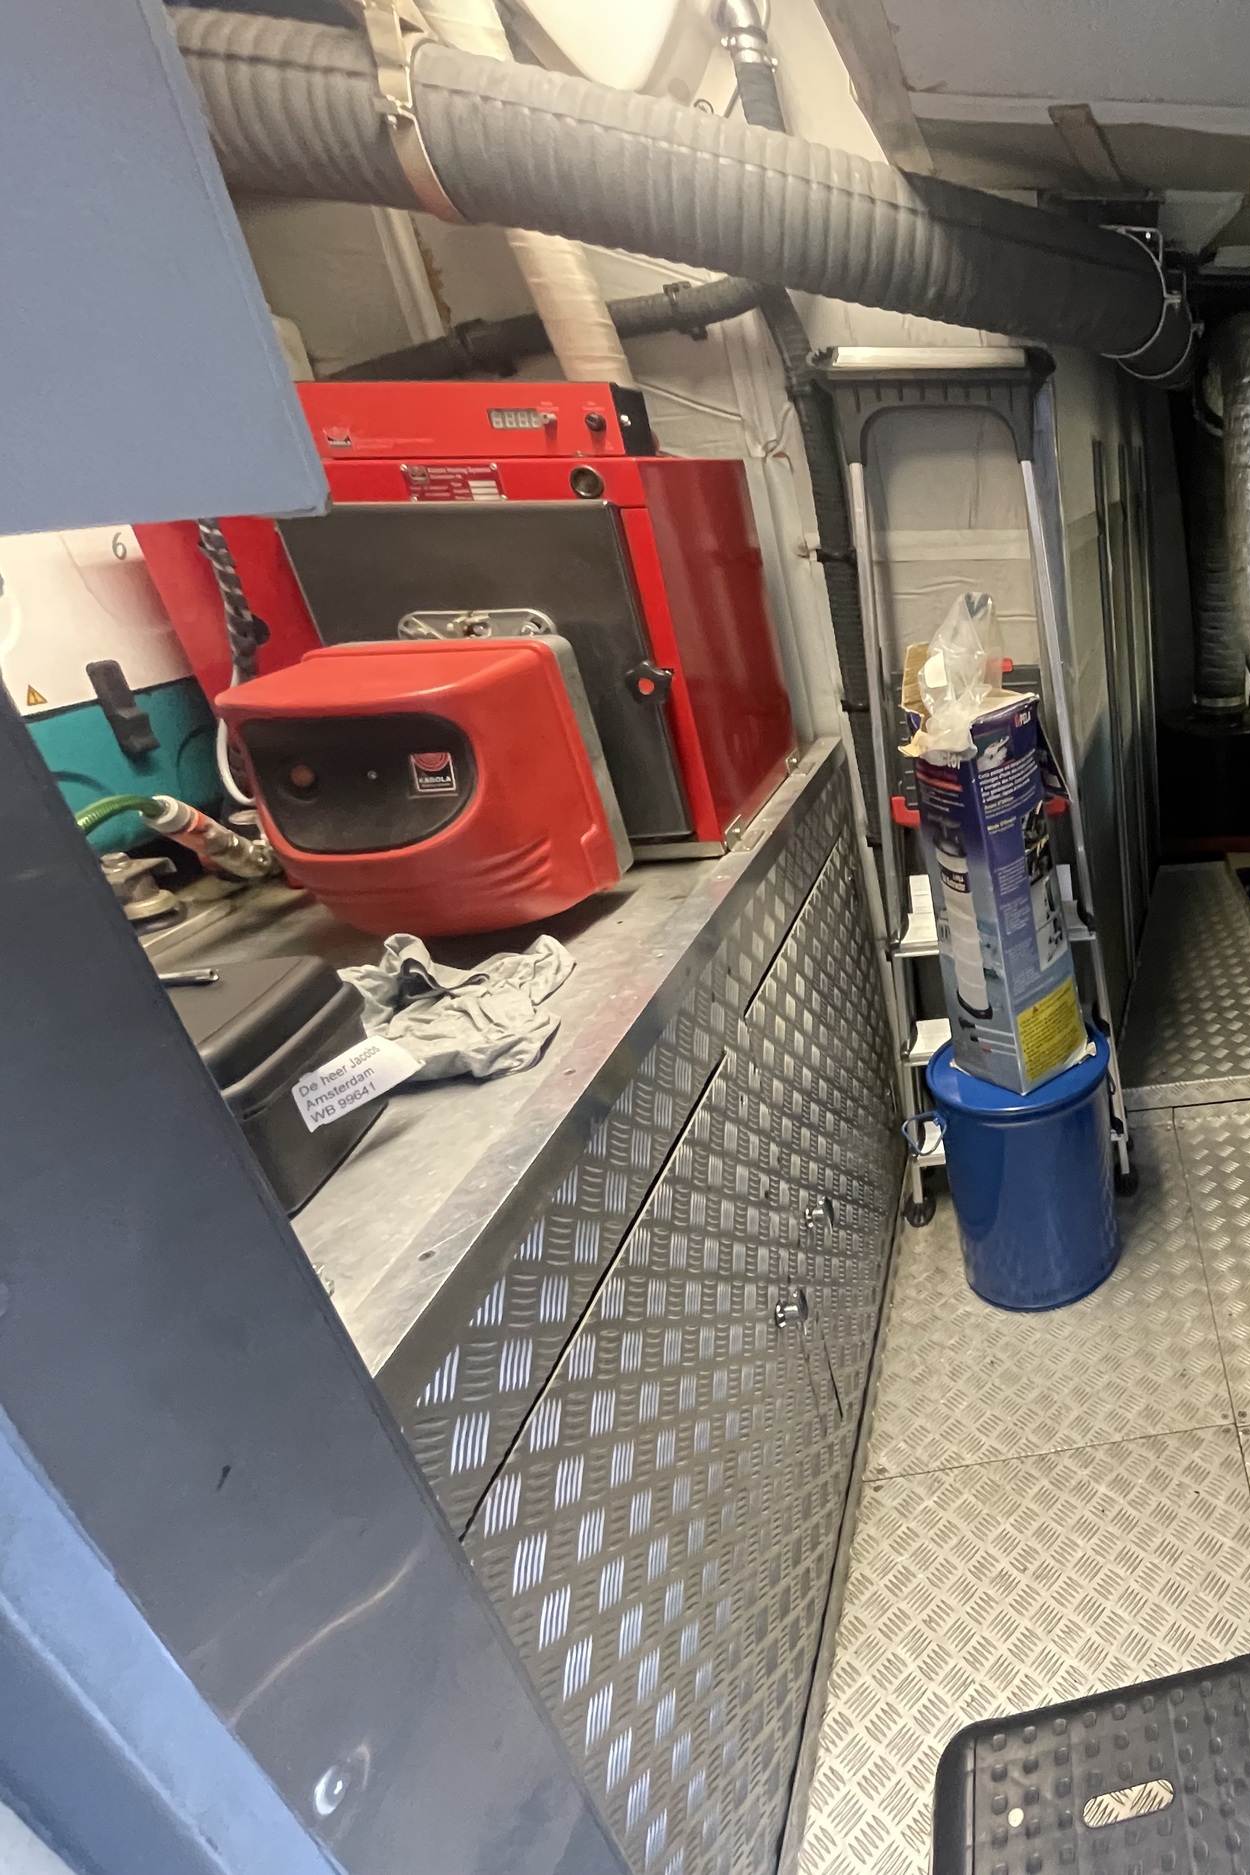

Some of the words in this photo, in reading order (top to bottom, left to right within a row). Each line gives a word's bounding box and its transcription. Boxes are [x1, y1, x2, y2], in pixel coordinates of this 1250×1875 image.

[112, 532, 127, 560] 6
[298, 1081, 319, 1098] De
[320, 1065, 349, 1086] heer
[349, 1045, 380, 1069] Jacobs
[306, 1066, 375, 1111] Amsterdam
[310, 1104, 336, 1123] WB
[338, 1082, 376, 1109] 99641
